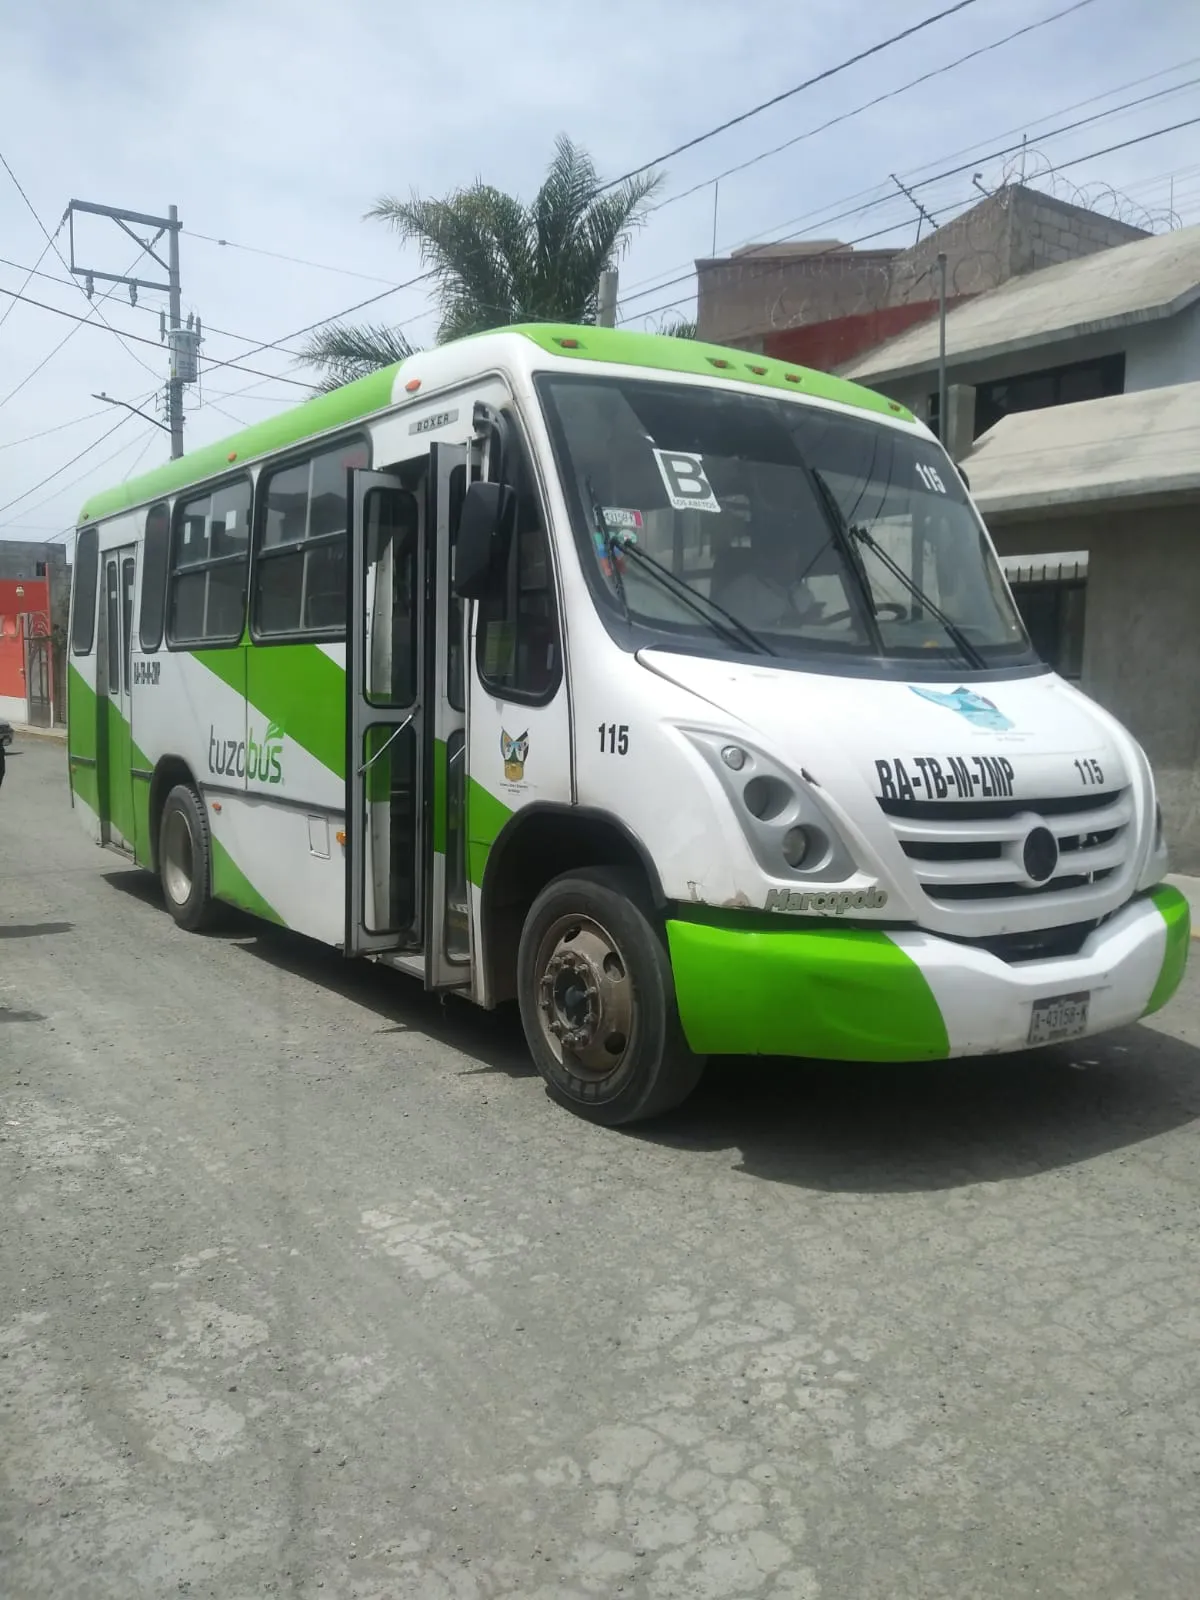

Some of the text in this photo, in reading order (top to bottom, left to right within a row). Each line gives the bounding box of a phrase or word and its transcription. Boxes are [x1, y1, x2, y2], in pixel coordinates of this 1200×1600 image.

[659, 453, 712, 500] B
[914, 462, 946, 494] 115
[208, 724, 283, 784] tuzobus
[598, 722, 630, 756] 115
[874, 756, 1016, 801] RA-TB-M-ZMP
[1074, 758, 1105, 786] 115
[764, 886, 888, 915] Marcopolo
